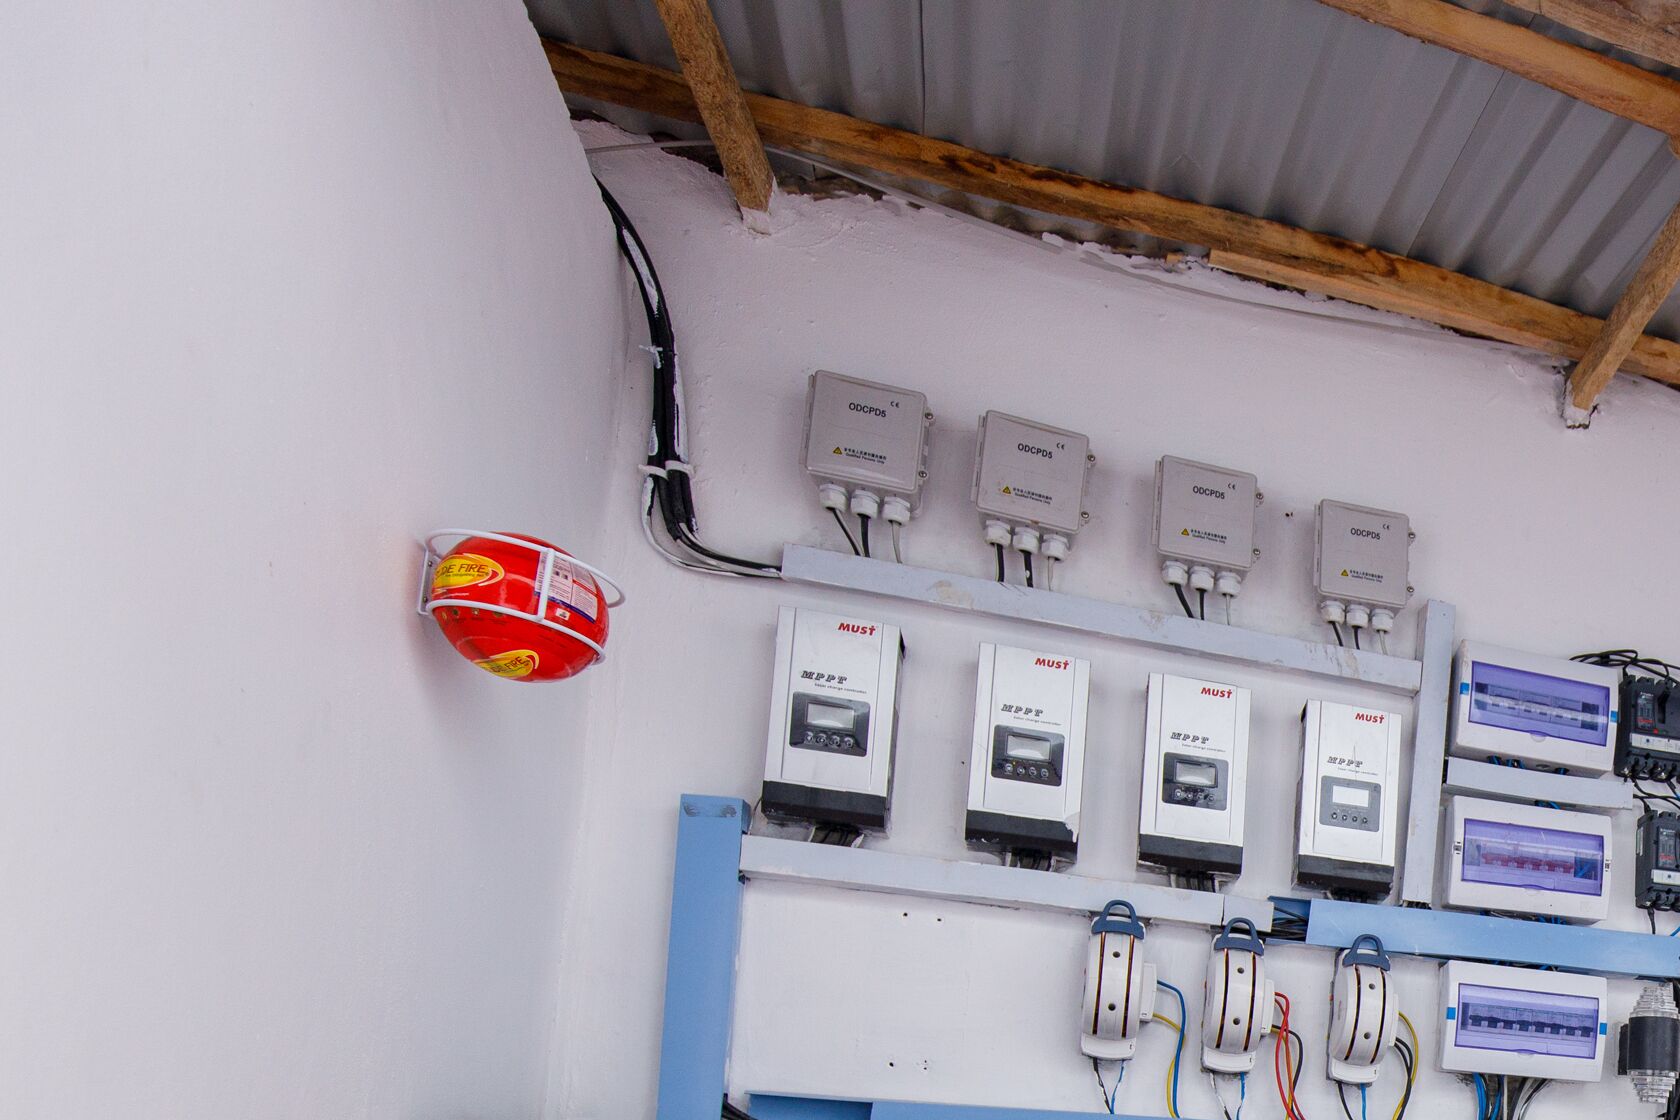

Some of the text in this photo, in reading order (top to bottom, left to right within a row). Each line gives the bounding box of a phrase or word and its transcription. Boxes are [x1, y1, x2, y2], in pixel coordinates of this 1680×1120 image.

[849, 402, 887, 418] ODCPD5
[1018, 443, 1053, 459] ODCPD5
[1193, 485, 1225, 499] ODCPD5
[1351, 527, 1381, 540] ODCPD5
[458, 563, 489, 574] FIRE
[801, 670, 847, 684] MPPT
[1001, 704, 1043, 717] MPPT
